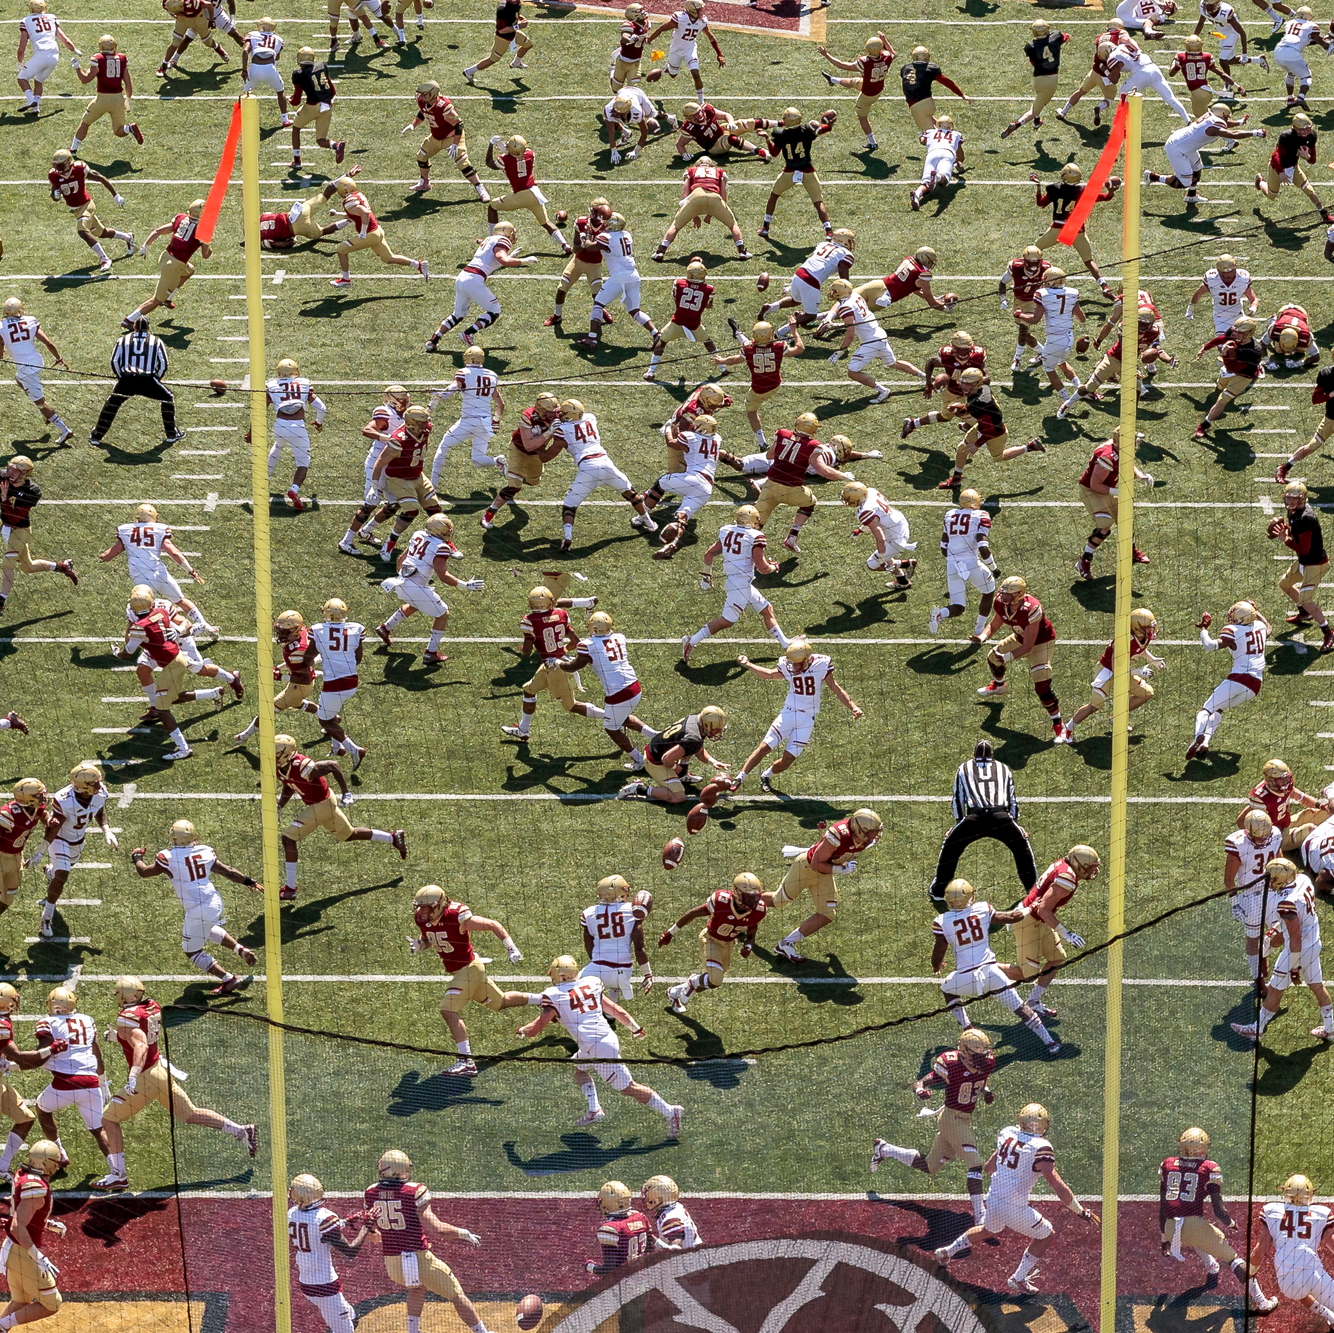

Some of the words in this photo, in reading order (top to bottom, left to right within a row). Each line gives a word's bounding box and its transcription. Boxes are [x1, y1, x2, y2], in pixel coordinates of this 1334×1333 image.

[107, 57, 120, 77] 81
[786, 142, 805, 159] 14
[680, 287, 704, 311] 23
[1219, 292, 1236, 306] 36
[8, 322, 30, 343] 25
[133, 338, 144, 354] U
[753, 349, 776, 373] 95
[574, 421, 597, 444] 44
[779, 438, 801, 464] 71
[950, 514, 971, 535] 29
[130, 527, 154, 547] 45
[724, 531, 744, 554] 45
[329, 627, 348, 651] 51
[1245, 630, 1264, 655] 20
[793, 676, 815, 695] 98
[978, 763, 992, 780] U
[185, 855, 206, 882] 16
[596, 907, 625, 940] 28
[953, 915, 983, 946] 28
[567, 985, 598, 1014] 45
[1280, 1210, 1312, 1239] 45
